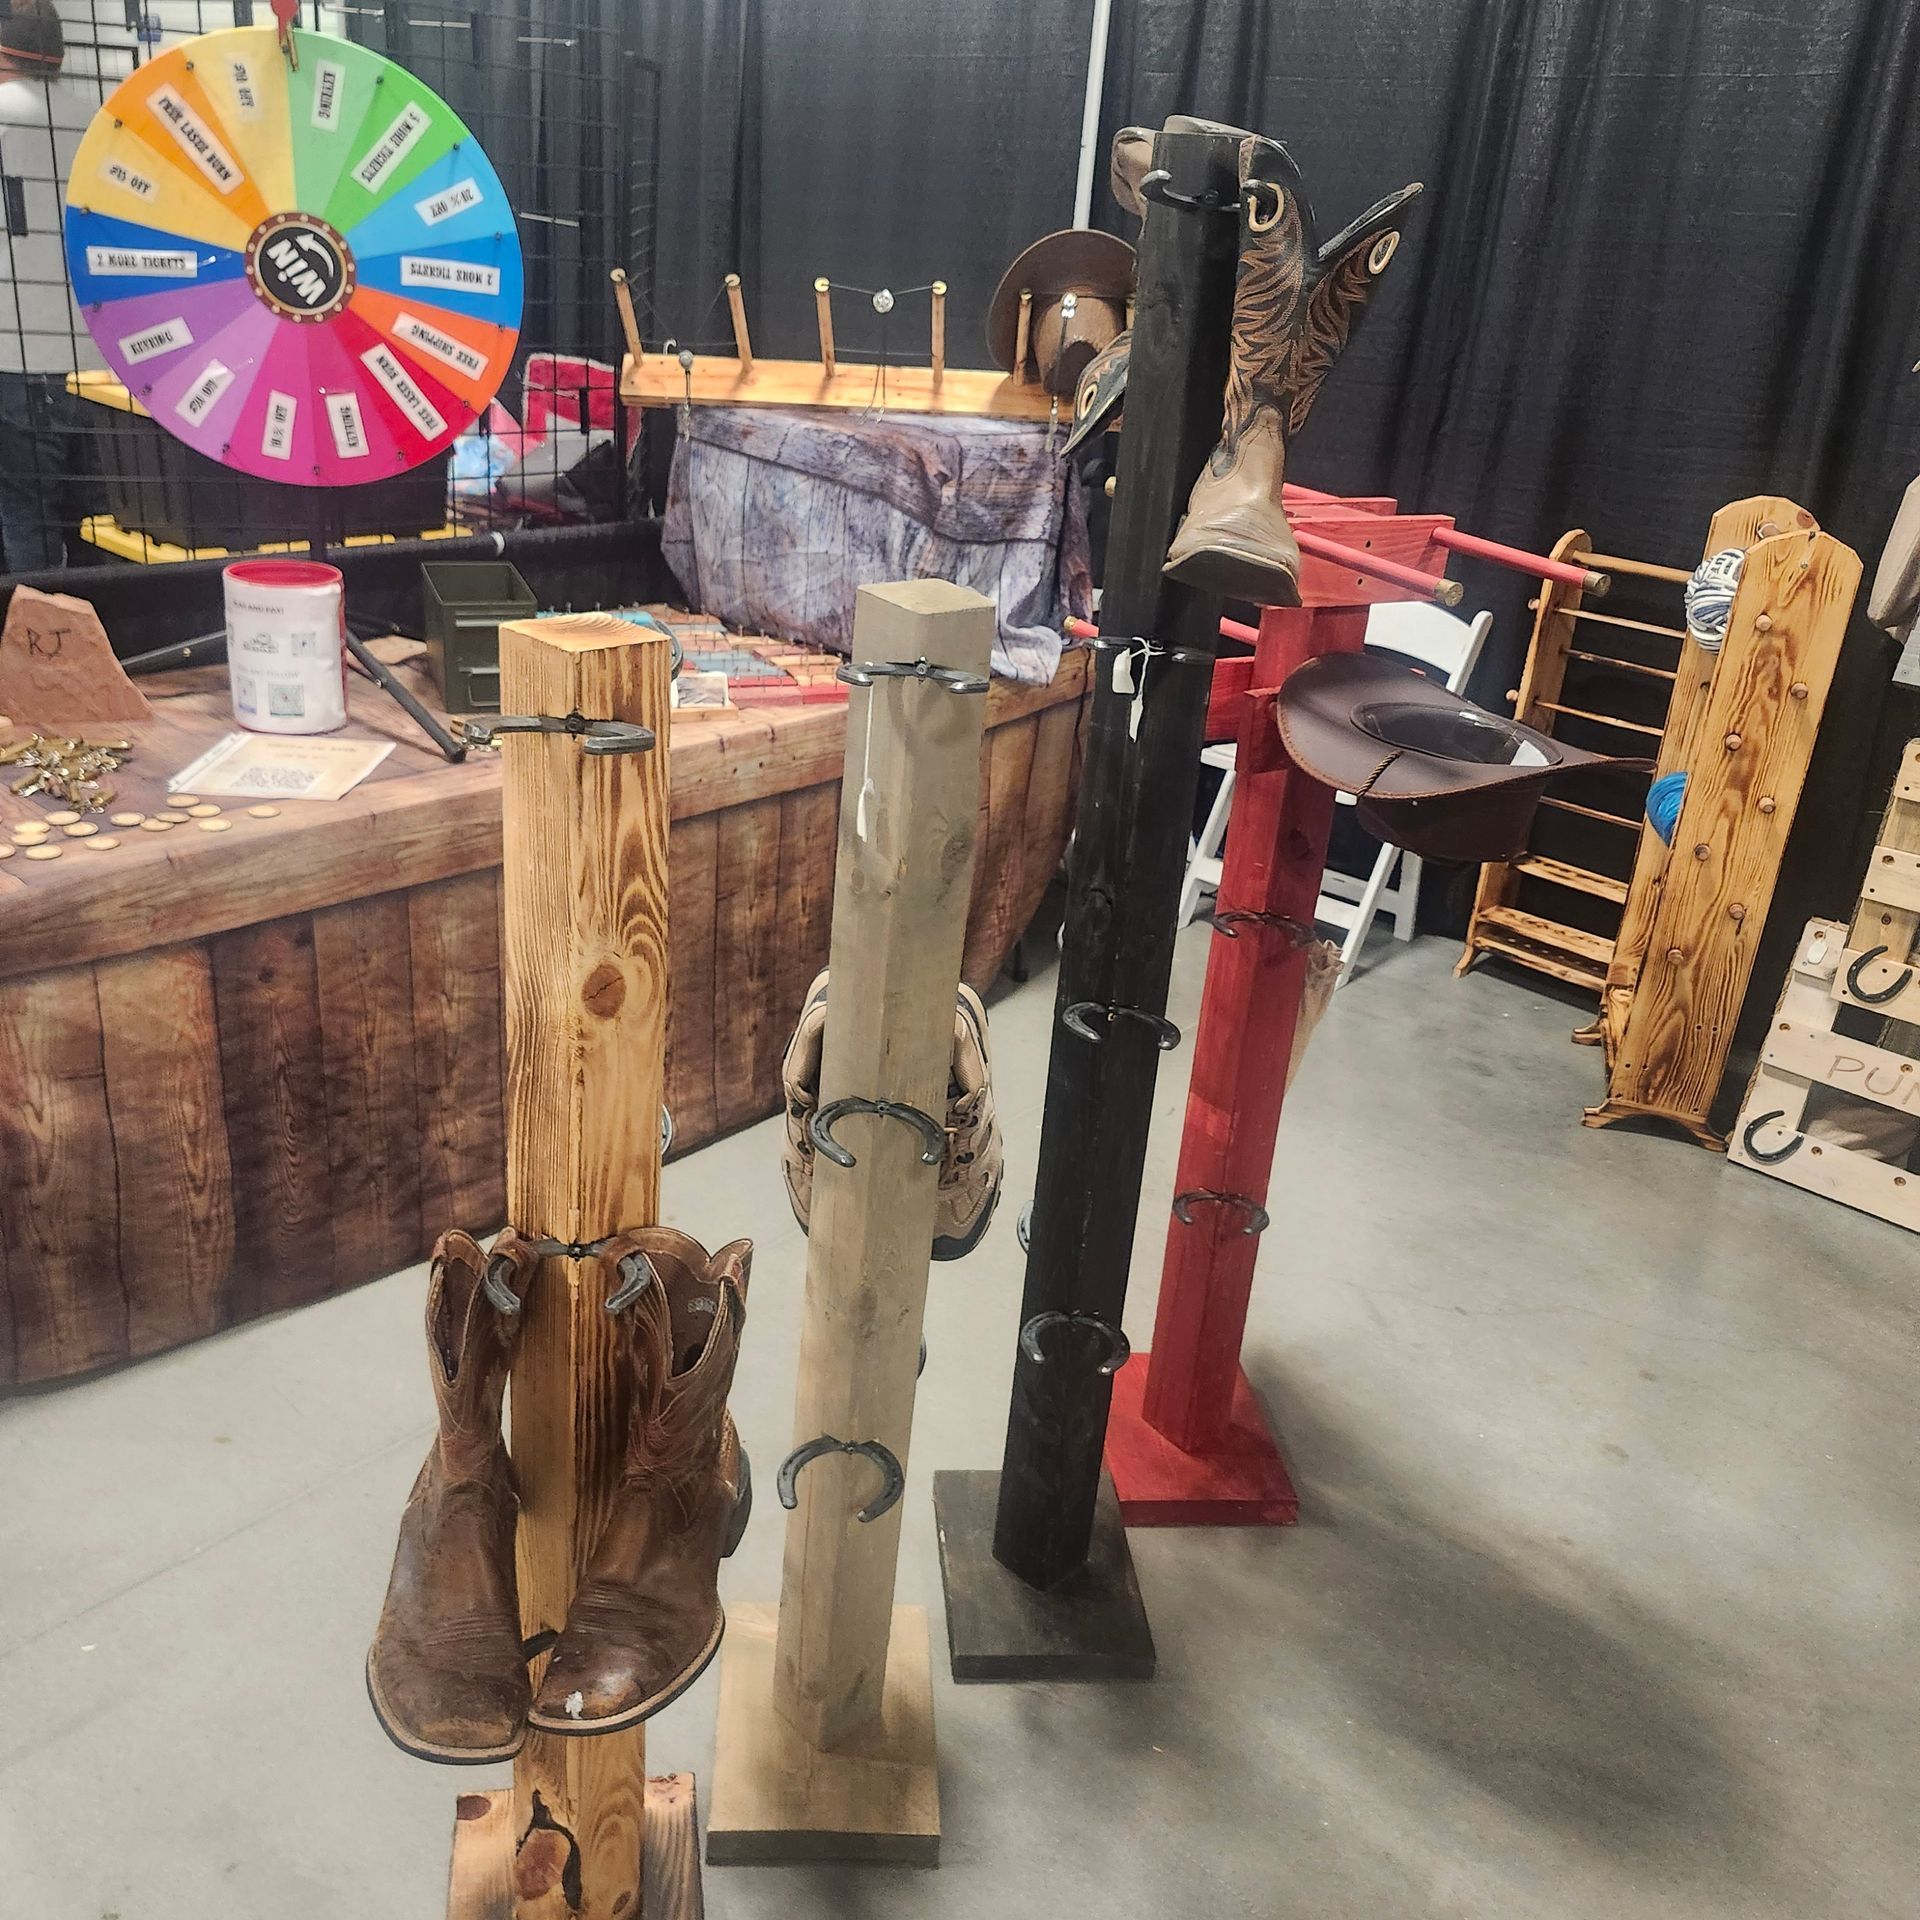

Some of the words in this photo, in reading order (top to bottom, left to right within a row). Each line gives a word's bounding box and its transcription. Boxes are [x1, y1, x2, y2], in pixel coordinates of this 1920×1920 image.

[158, 96, 183, 123] FREE
[180, 122, 209, 154] LASER
[206, 153, 232, 181] BURN
[108, 254, 137, 267] MORE
[142, 256, 185, 269] TICKETS
[410, 263, 450, 280] TICKETS
[456, 269, 482, 283] MORE
[130, 330, 173, 355] KEYRING
[410, 325, 455, 356] SHIPPING
[376, 355, 398, 380] BURN
[456, 351, 479, 369] FREE
[396, 380, 420, 408] LASER
[417, 407, 438, 430] FREE
[27, 627, 71, 660] RJ
